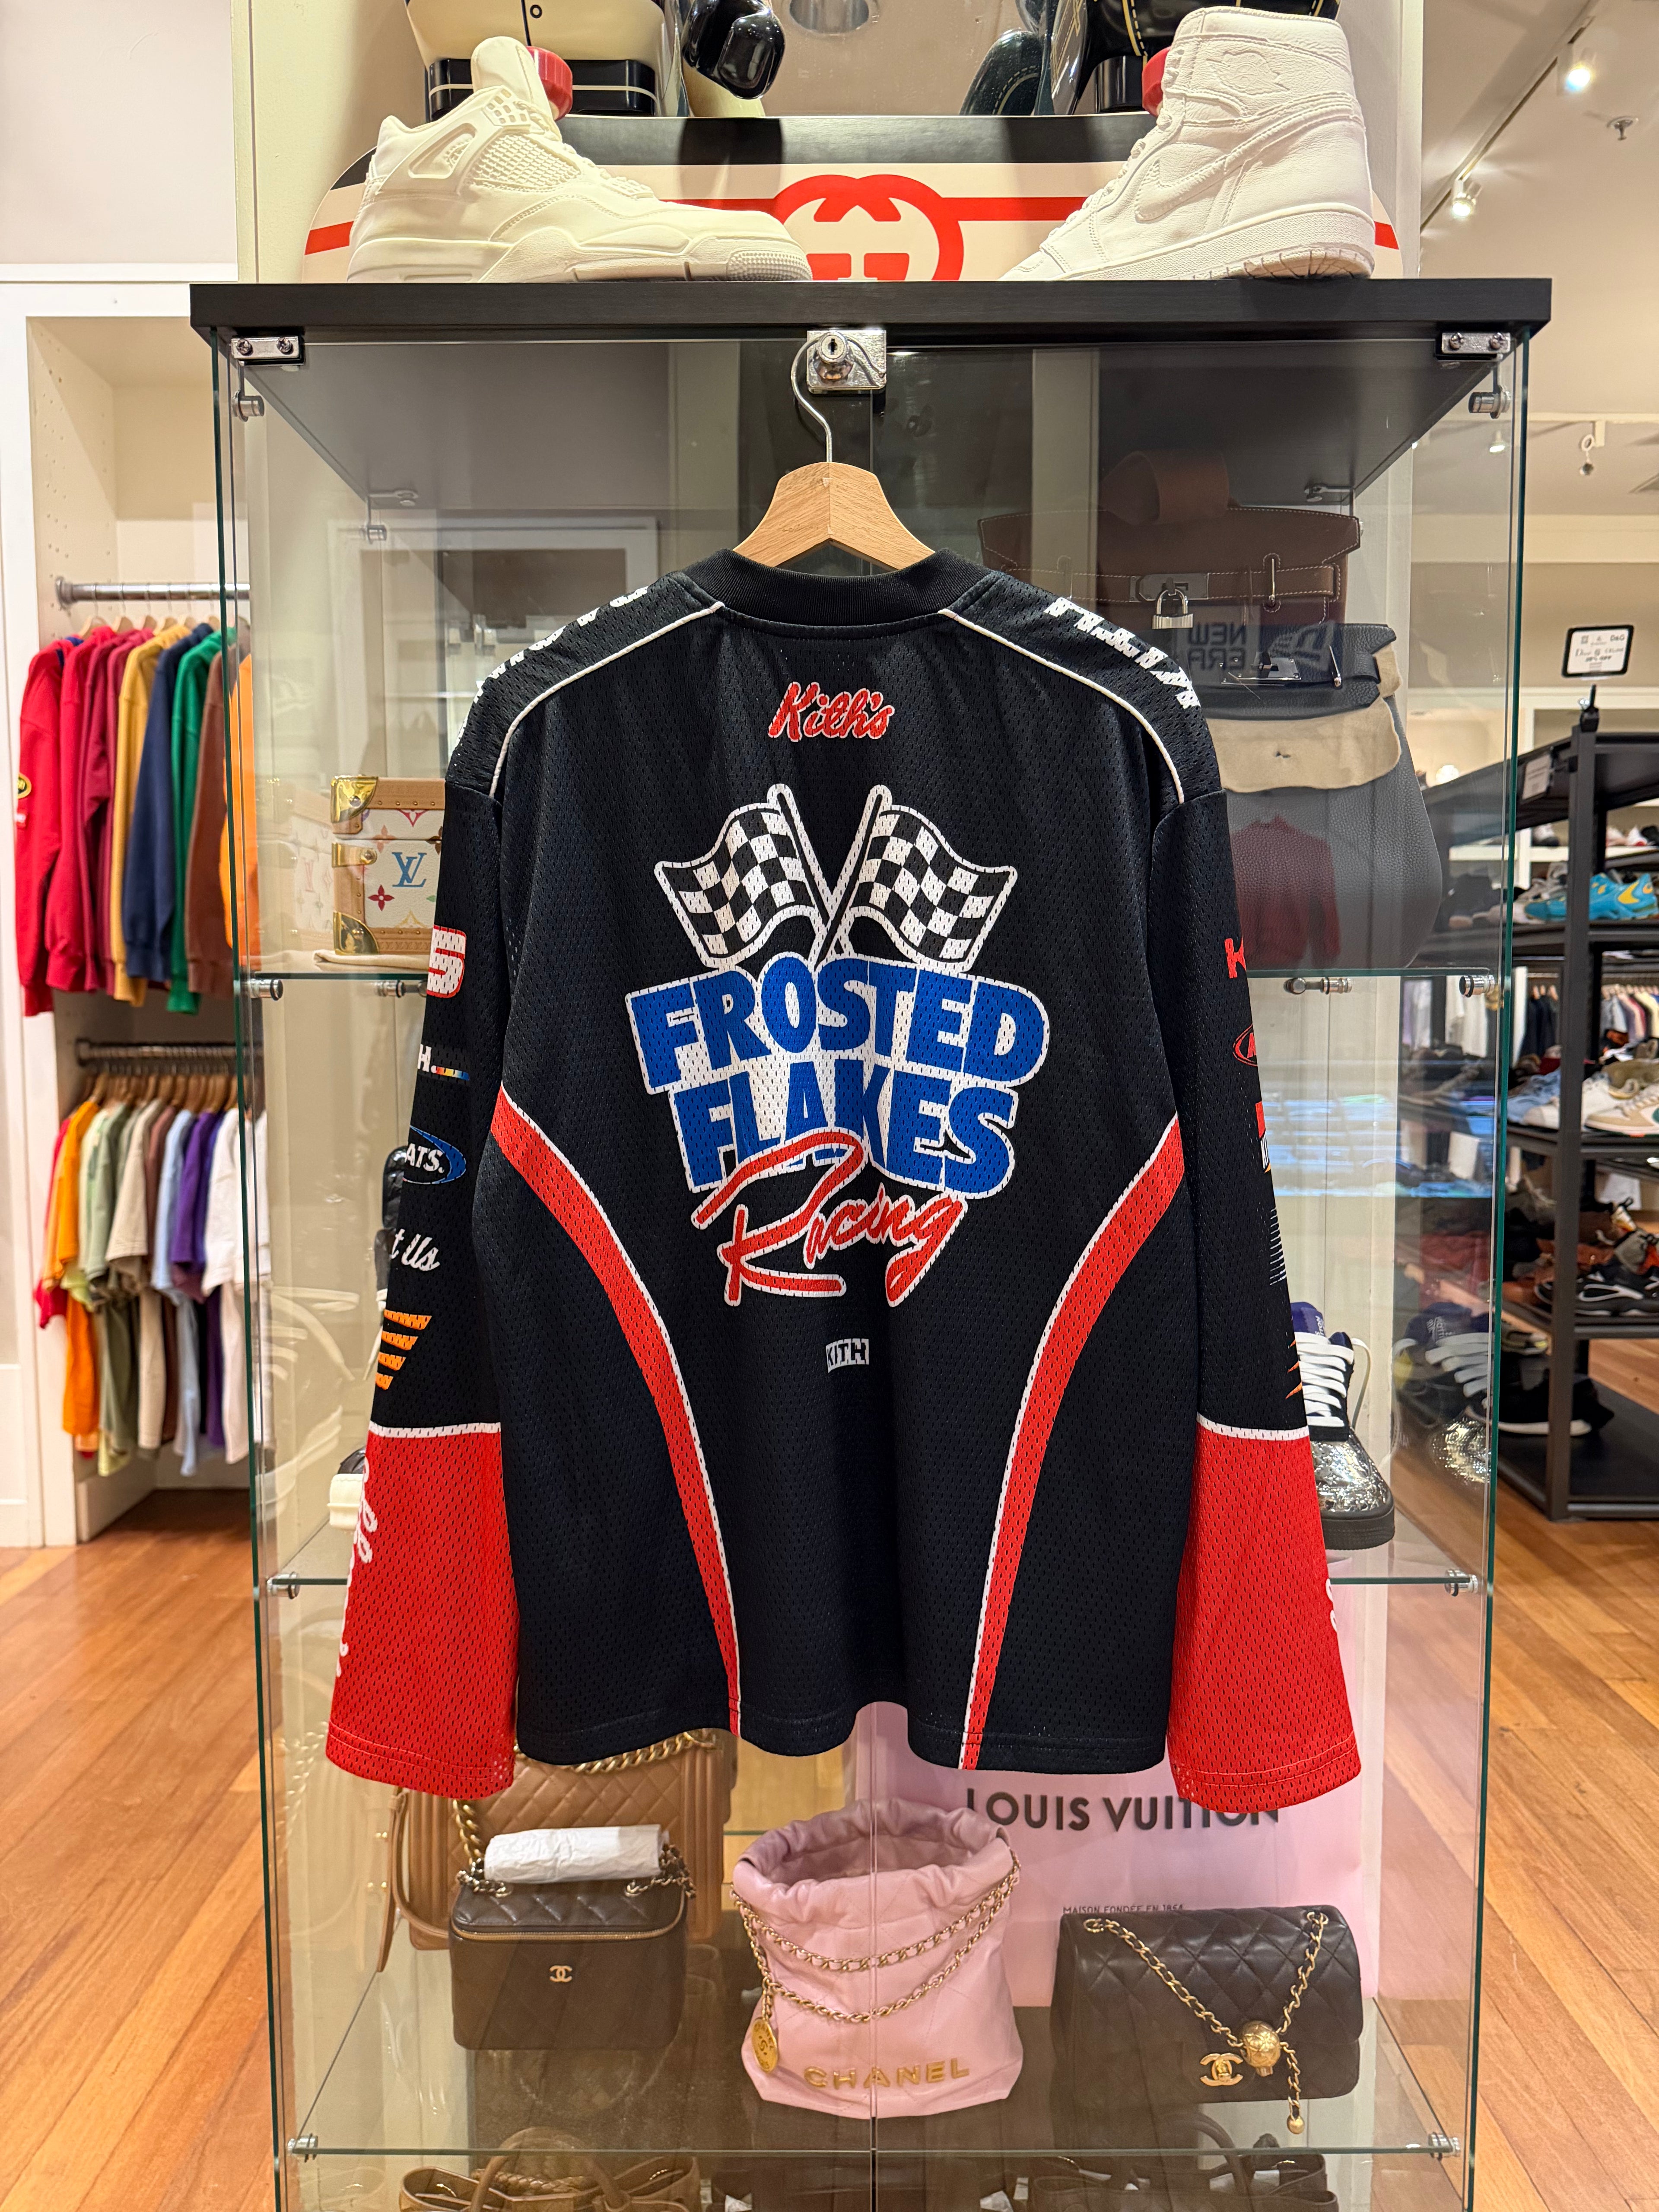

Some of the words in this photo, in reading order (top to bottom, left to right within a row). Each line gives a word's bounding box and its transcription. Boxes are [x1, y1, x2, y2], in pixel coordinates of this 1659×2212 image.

[768, 681, 895, 743] Kith's
[625, 952, 1050, 1095] FROSTED
[668, 1055, 1019, 1199] FLAKES
[691, 1126, 968, 1307] Racing
[826, 1341, 868, 1369] KITH
[1062, 1906, 1100, 1914] MAISON
[804, 2058, 970, 2090] CHANEL
